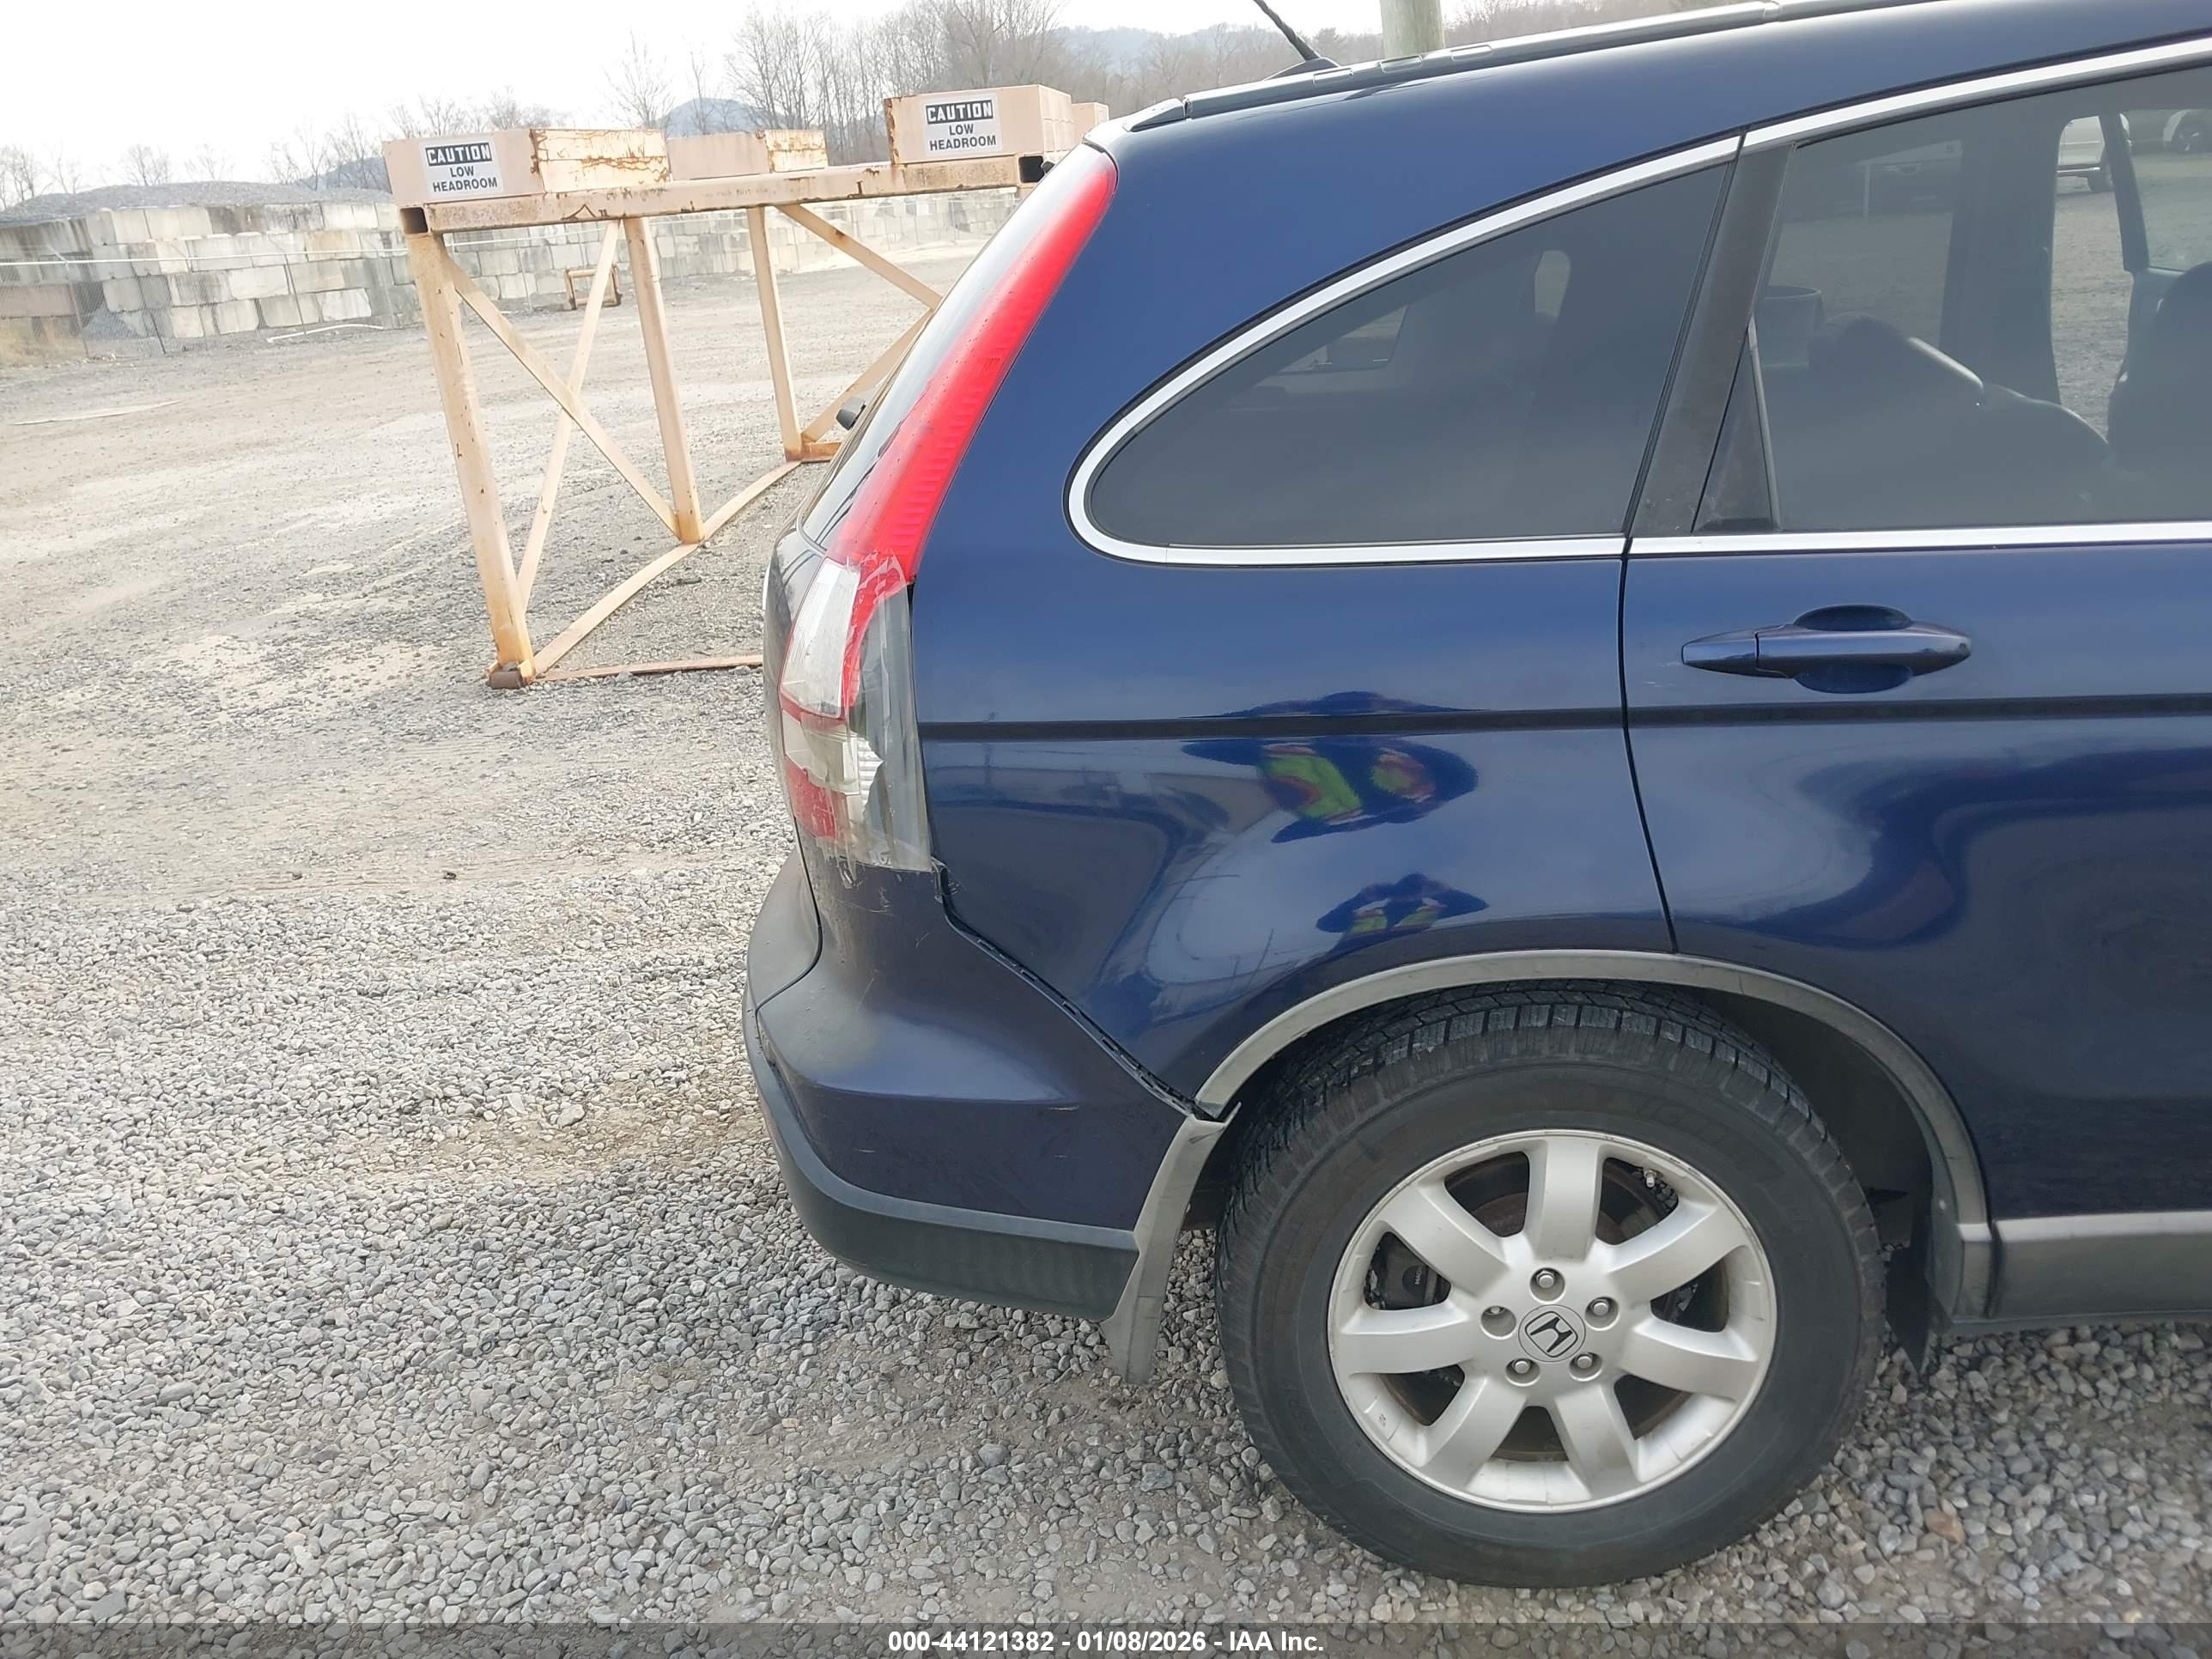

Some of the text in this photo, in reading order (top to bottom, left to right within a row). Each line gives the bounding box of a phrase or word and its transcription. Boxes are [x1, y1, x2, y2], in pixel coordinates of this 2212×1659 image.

[927, 101, 993, 122] CAUTION
[949, 124, 974, 136] LOW
[929, 135, 996, 150] HEADROOM
[427, 144, 491, 164] CAUTION
[450, 166, 474, 178] LOW
[433, 177, 498, 192] HEADROOM
